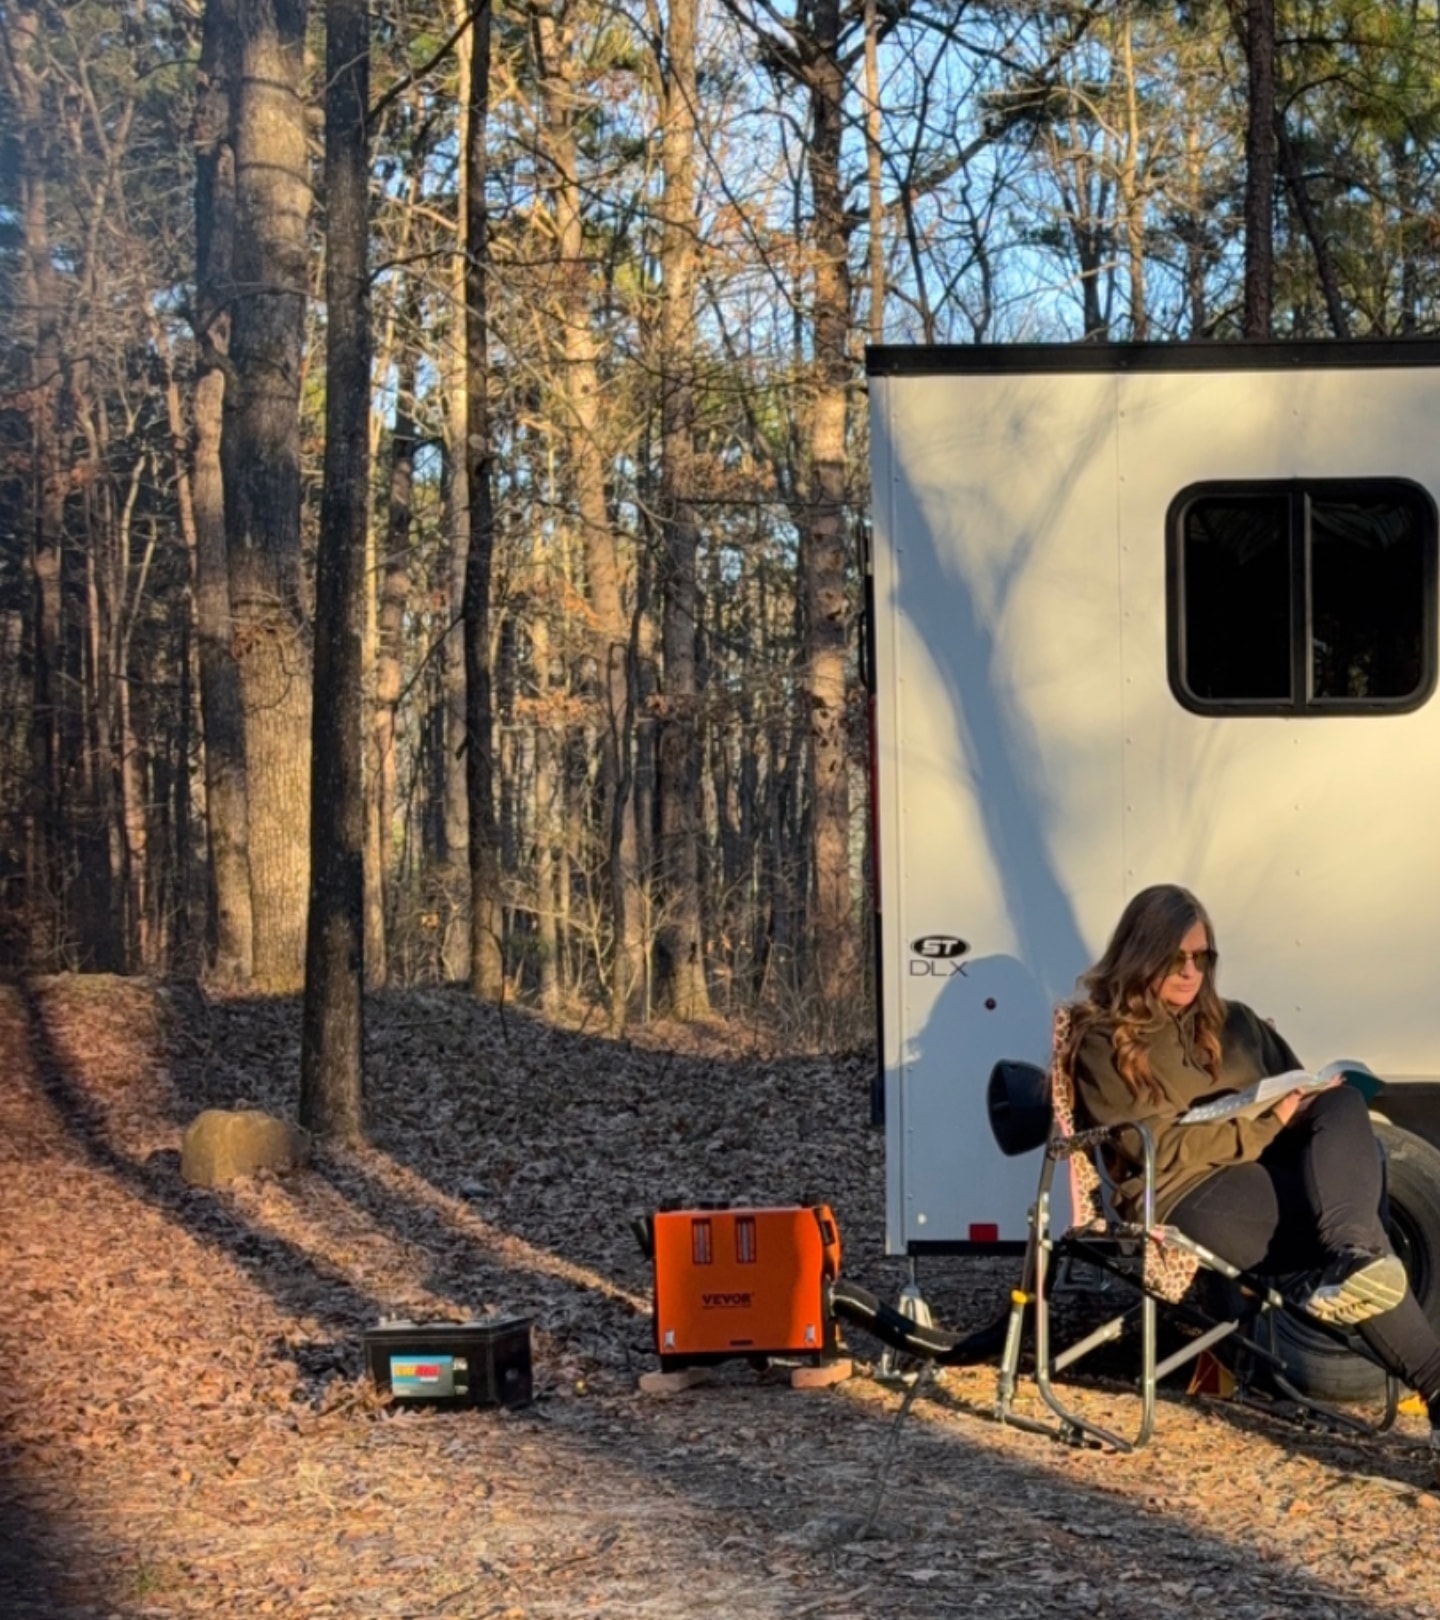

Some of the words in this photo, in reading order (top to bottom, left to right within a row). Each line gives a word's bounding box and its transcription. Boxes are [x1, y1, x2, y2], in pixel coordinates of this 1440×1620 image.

[921, 939, 959, 955] ST
[910, 959, 968, 976] DLX
[702, 1293, 751, 1304] VEVOR
